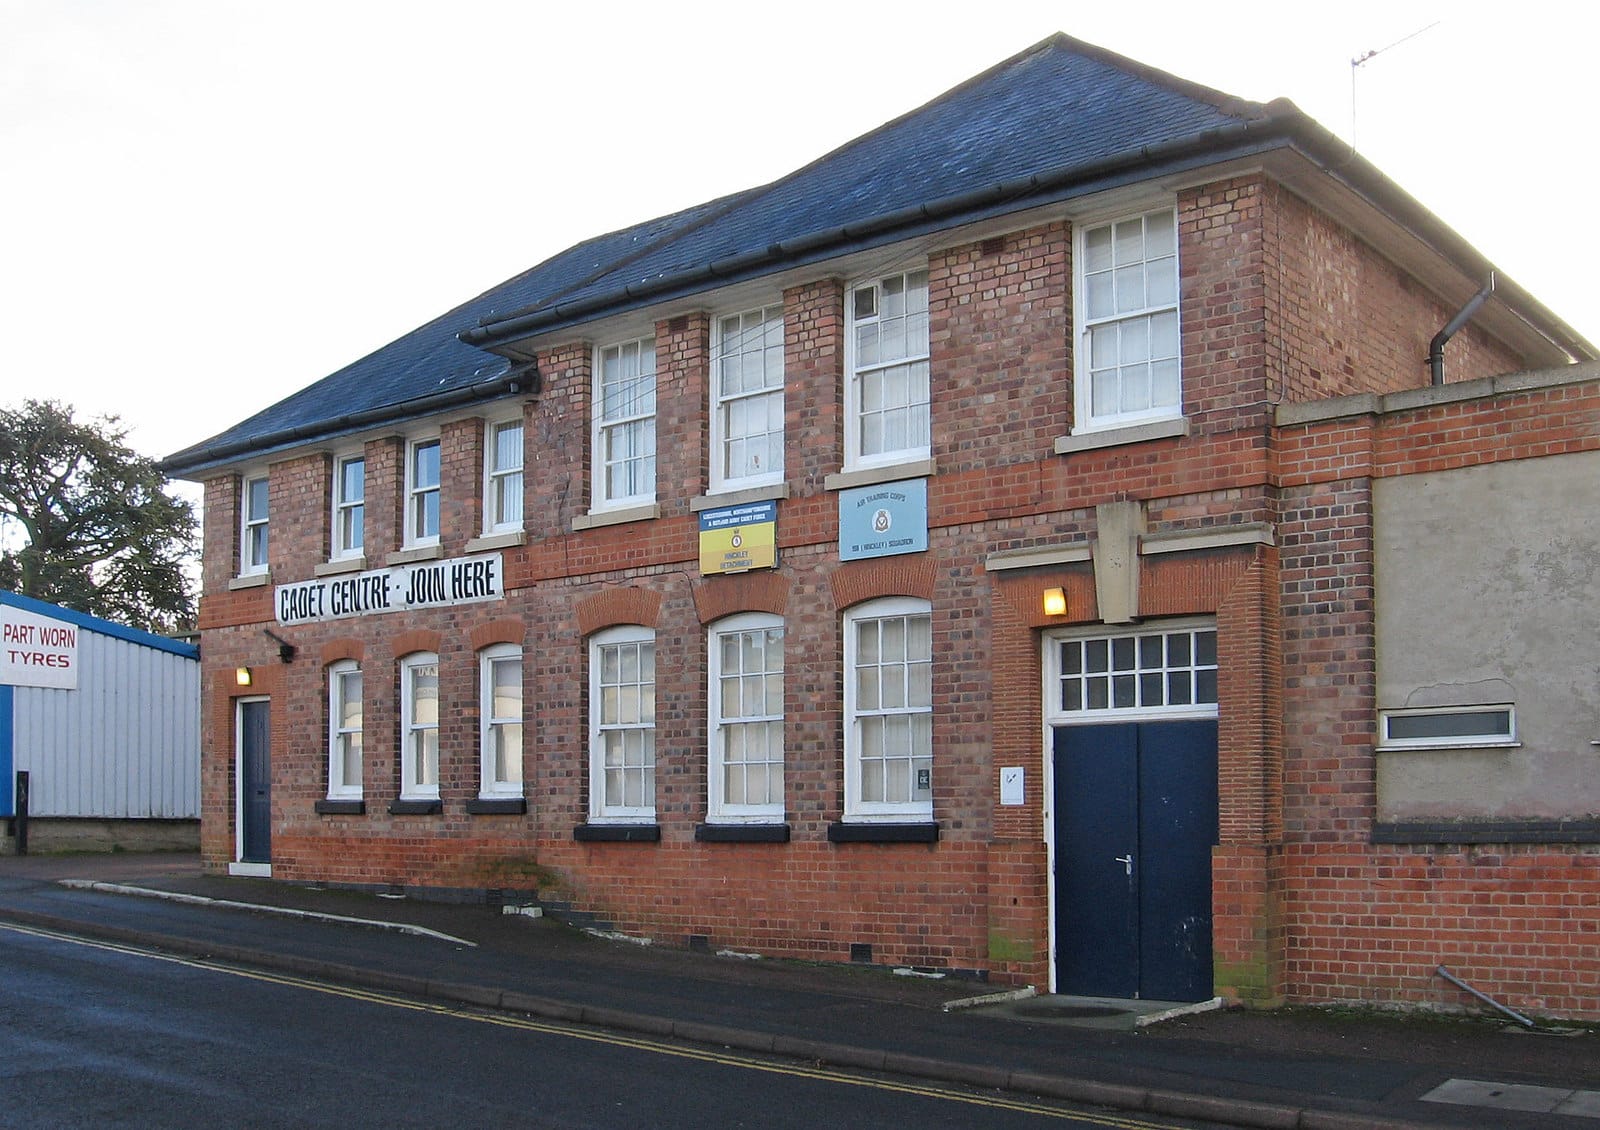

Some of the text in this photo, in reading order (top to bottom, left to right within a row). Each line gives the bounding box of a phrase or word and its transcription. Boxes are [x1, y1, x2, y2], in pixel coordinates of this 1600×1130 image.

[857, 499, 866, 508] AIR
[280, 560, 495, 622] CADET CENTRE JOIN HERE
[3, 624, 75, 648] PART WORN
[7, 650, 70, 668] TYRES
